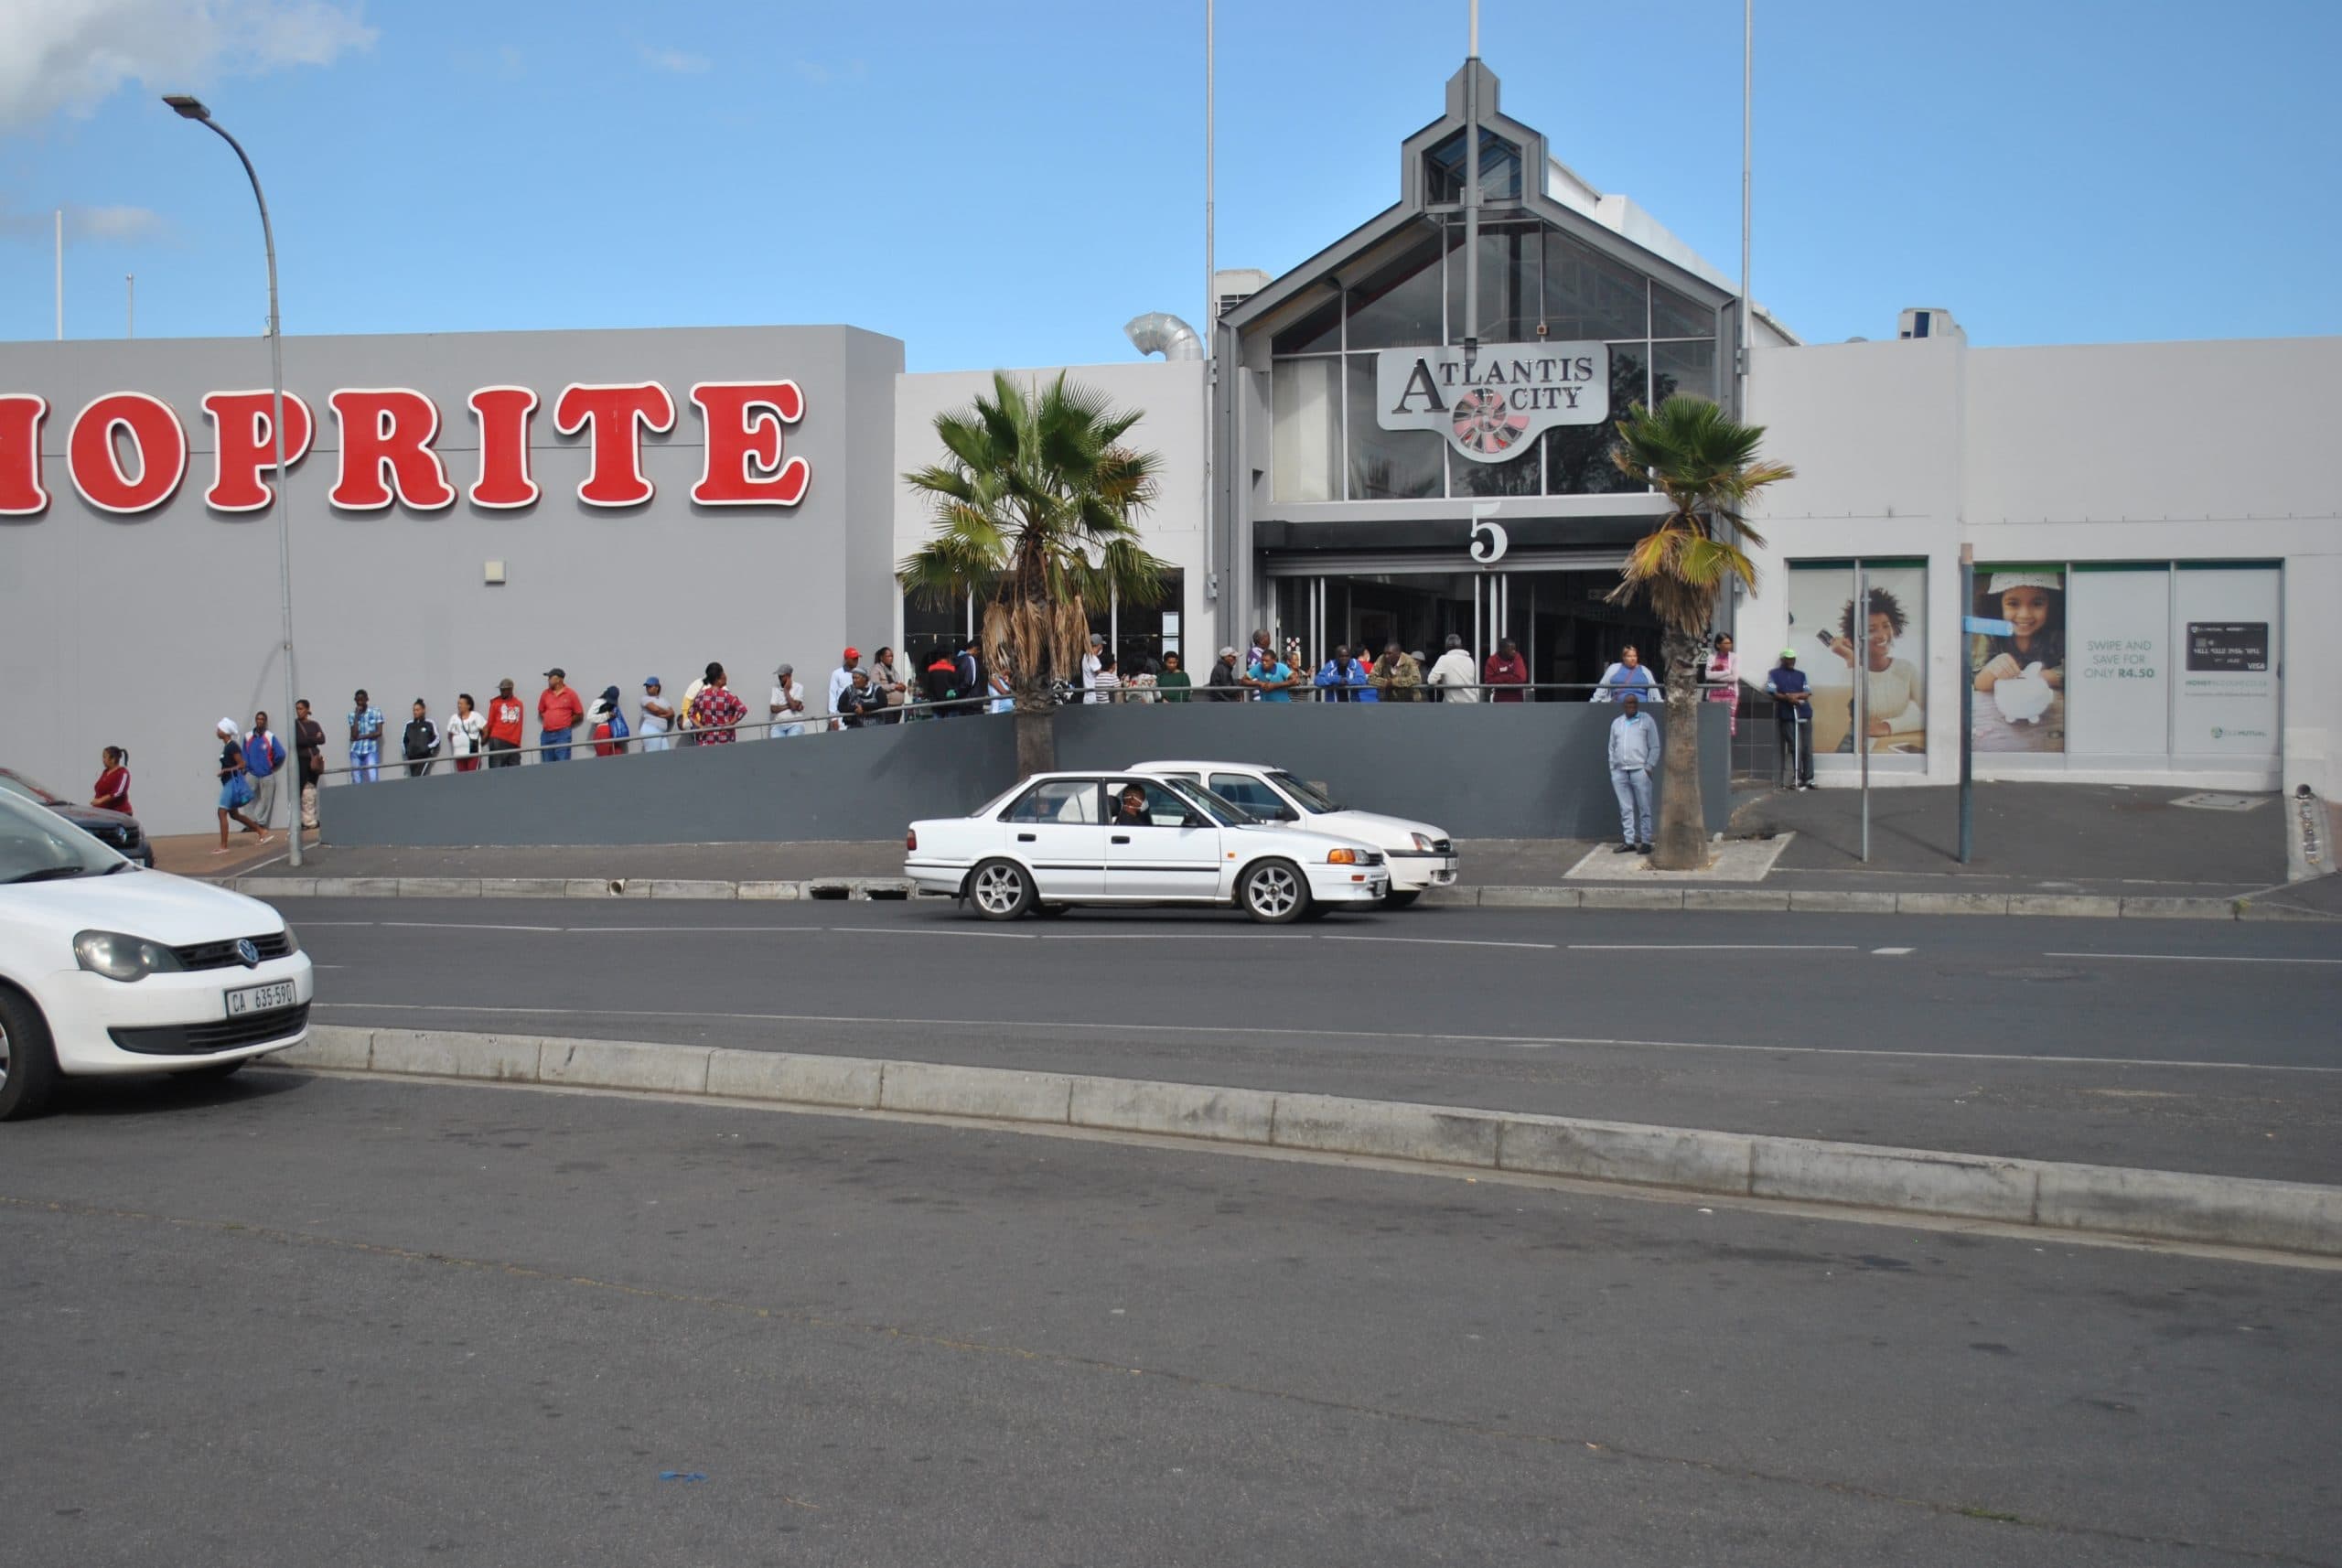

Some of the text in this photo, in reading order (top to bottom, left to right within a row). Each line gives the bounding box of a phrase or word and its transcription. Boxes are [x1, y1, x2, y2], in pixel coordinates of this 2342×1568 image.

[1391, 356, 1594, 414] ATLANTIS
[1509, 386, 1583, 411] CITY
[1469, 501, 1508, 564] 5
[2087, 639, 2152, 650] SWIPE AND
[2092, 654, 2145, 665] SAVE FOR
[2084, 668, 2154, 678] ONLY R4.50
[232, 983, 293, 1012] CA 635-590
